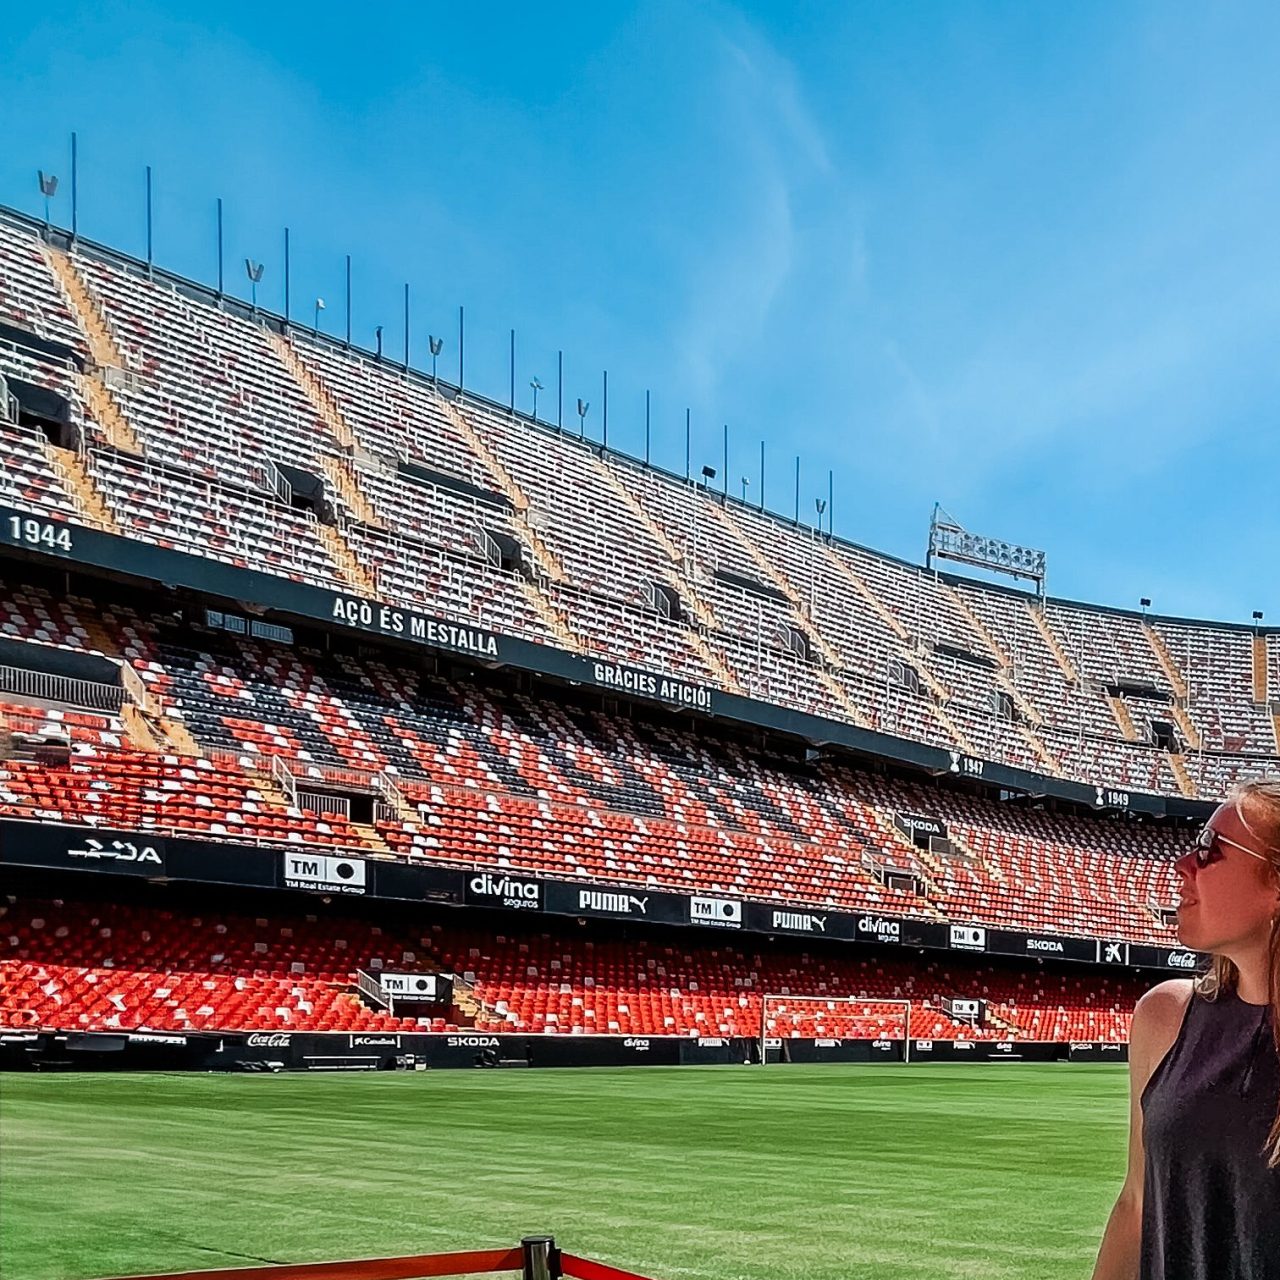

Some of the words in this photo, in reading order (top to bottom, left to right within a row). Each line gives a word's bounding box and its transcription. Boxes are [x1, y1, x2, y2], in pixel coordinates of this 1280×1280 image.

[8, 515, 74, 551] 1944
[332, 597, 373, 627] AÇÒ
[379, 605, 404, 633] ÉS
[410, 616, 499, 656] MESTALLA
[594, 662, 657, 694] GRÀCIES
[660, 679, 712, 708] AFICIÓ!
[963, 757, 985, 775] 1947
[1107, 791, 1129, 806] 1949
[290, 859, 319, 876] TM
[470, 873, 539, 899] divina
[503, 897, 539, 909] seguros
[579, 889, 632, 913] PUMA
[694, 902, 712, 915] TM
[772, 910, 814, 932] PUMA
[858, 915, 900, 936] divina
[384, 979, 404, 990] TM
